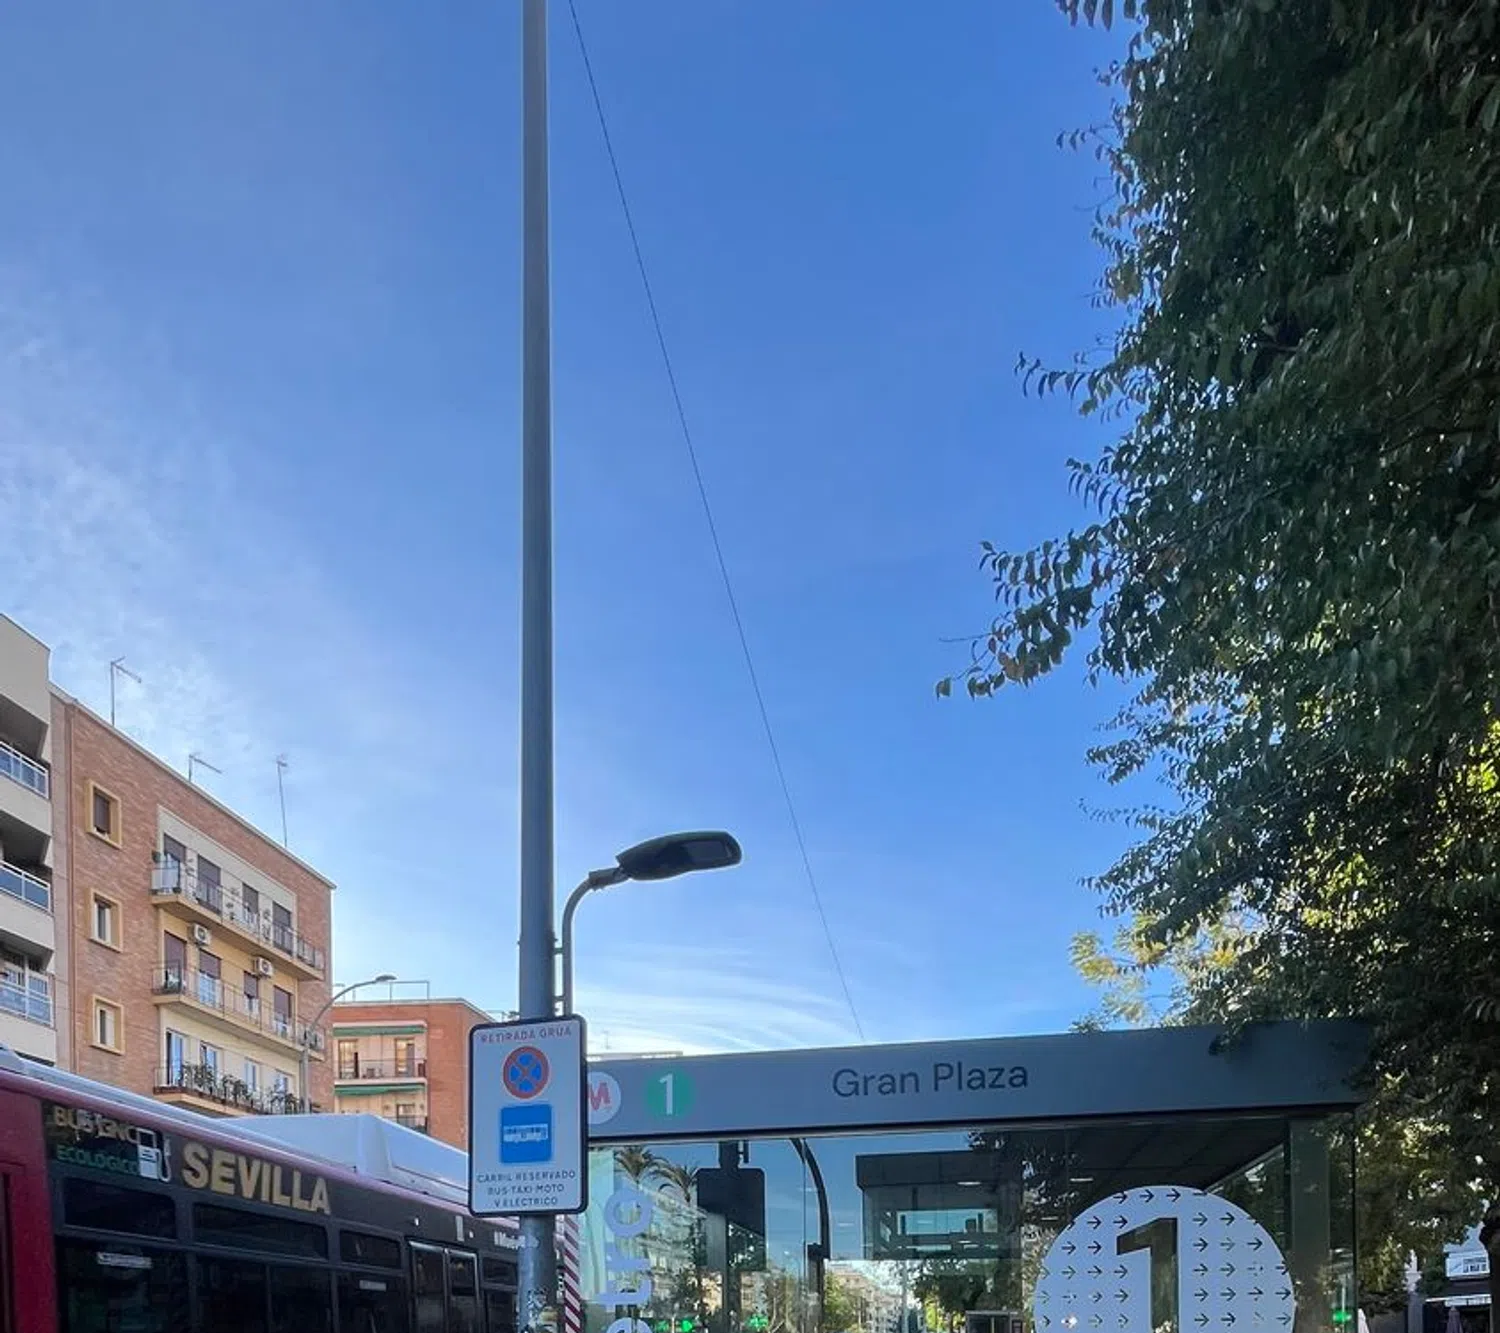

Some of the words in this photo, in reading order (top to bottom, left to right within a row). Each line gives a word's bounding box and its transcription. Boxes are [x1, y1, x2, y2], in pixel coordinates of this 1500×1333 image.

[481, 1031, 536, 1044] RETIRADA
[540, 1026, 572, 1039] GRUA
[659, 1073, 674, 1116] 1
[832, 1068, 920, 1097] Gran
[933, 1061, 1028, 1092] Plaza
[181, 1142, 331, 1216] SEVILLA
[477, 1172, 513, 1183] CARRIL
[515, 1169, 576, 1182] RESERVADO
